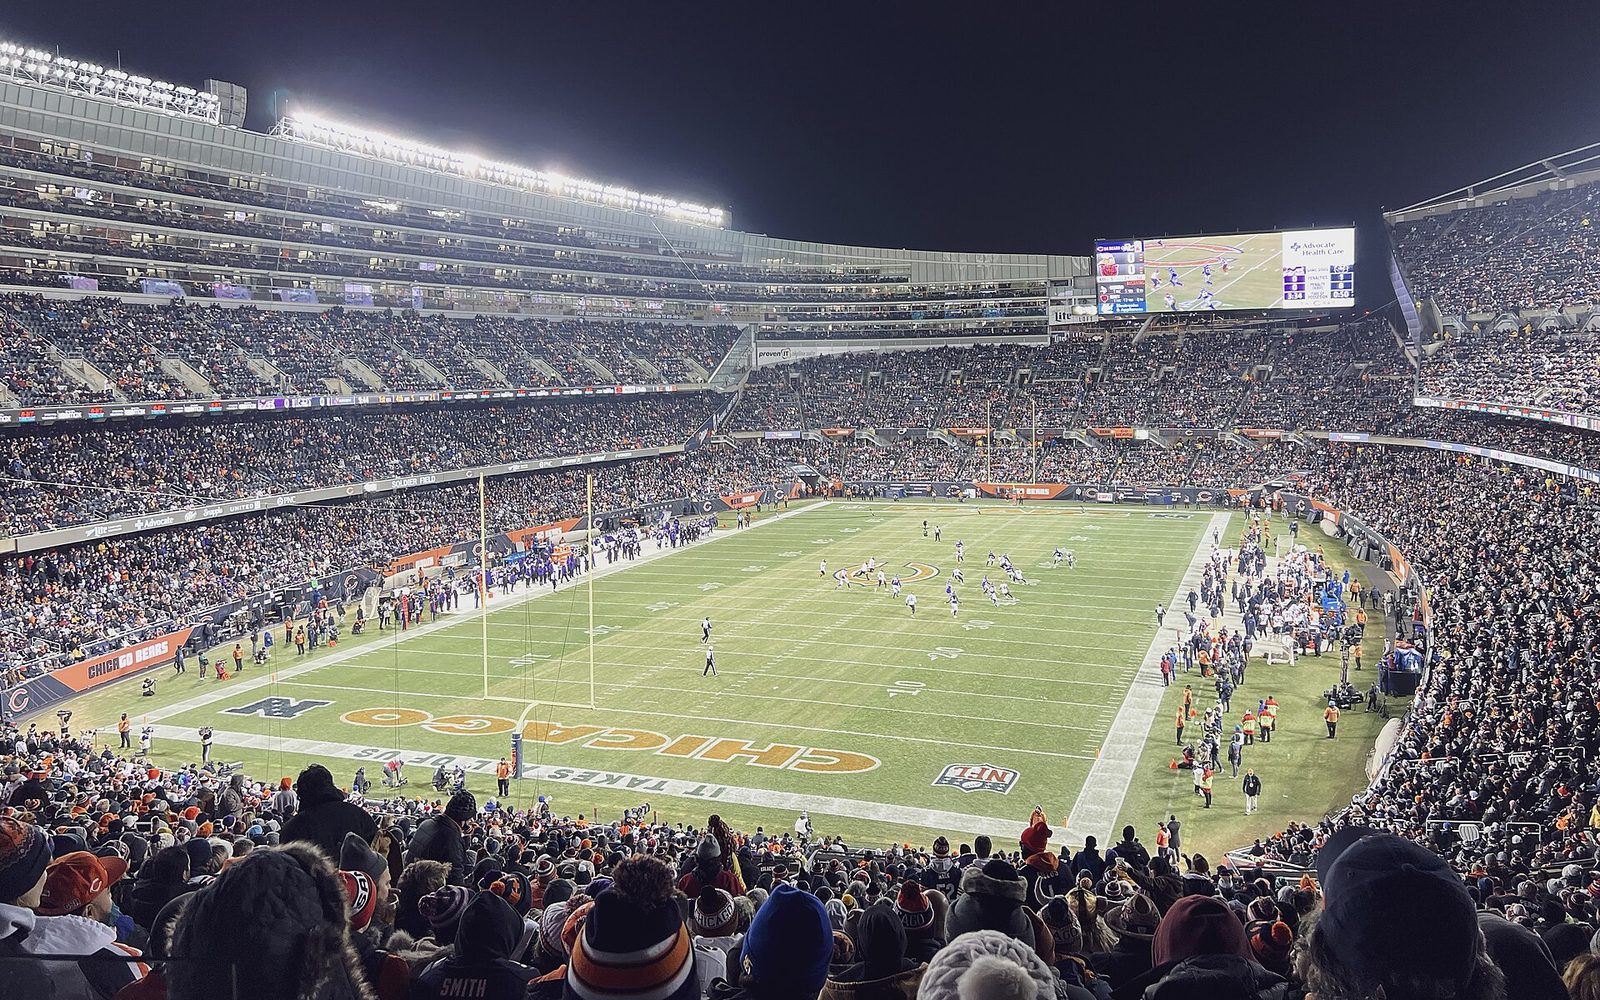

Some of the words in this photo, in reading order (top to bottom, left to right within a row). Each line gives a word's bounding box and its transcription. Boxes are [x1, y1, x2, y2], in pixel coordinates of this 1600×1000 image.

[1055, 312, 1072, 323] Lite
[391, 479, 417, 489] SOLDIER
[419, 475, 436, 484] FIELD
[229, 503, 254, 513] UNITED
[143, 516, 174, 528] Advocate
[87, 652, 134, 680] CHICAGO
[135, 640, 169, 663] BEARS
[887, 680, 927, 698] 10
[340, 707, 881, 774] CHICAGO
[353, 748, 401, 761] US
[407, 754, 456, 767] OF
[547, 768, 670, 792] TAKES
[954, 765, 1009, 783] NFL
[683, 783, 728, 798] IT
[439, 977, 487, 997] SMITH
